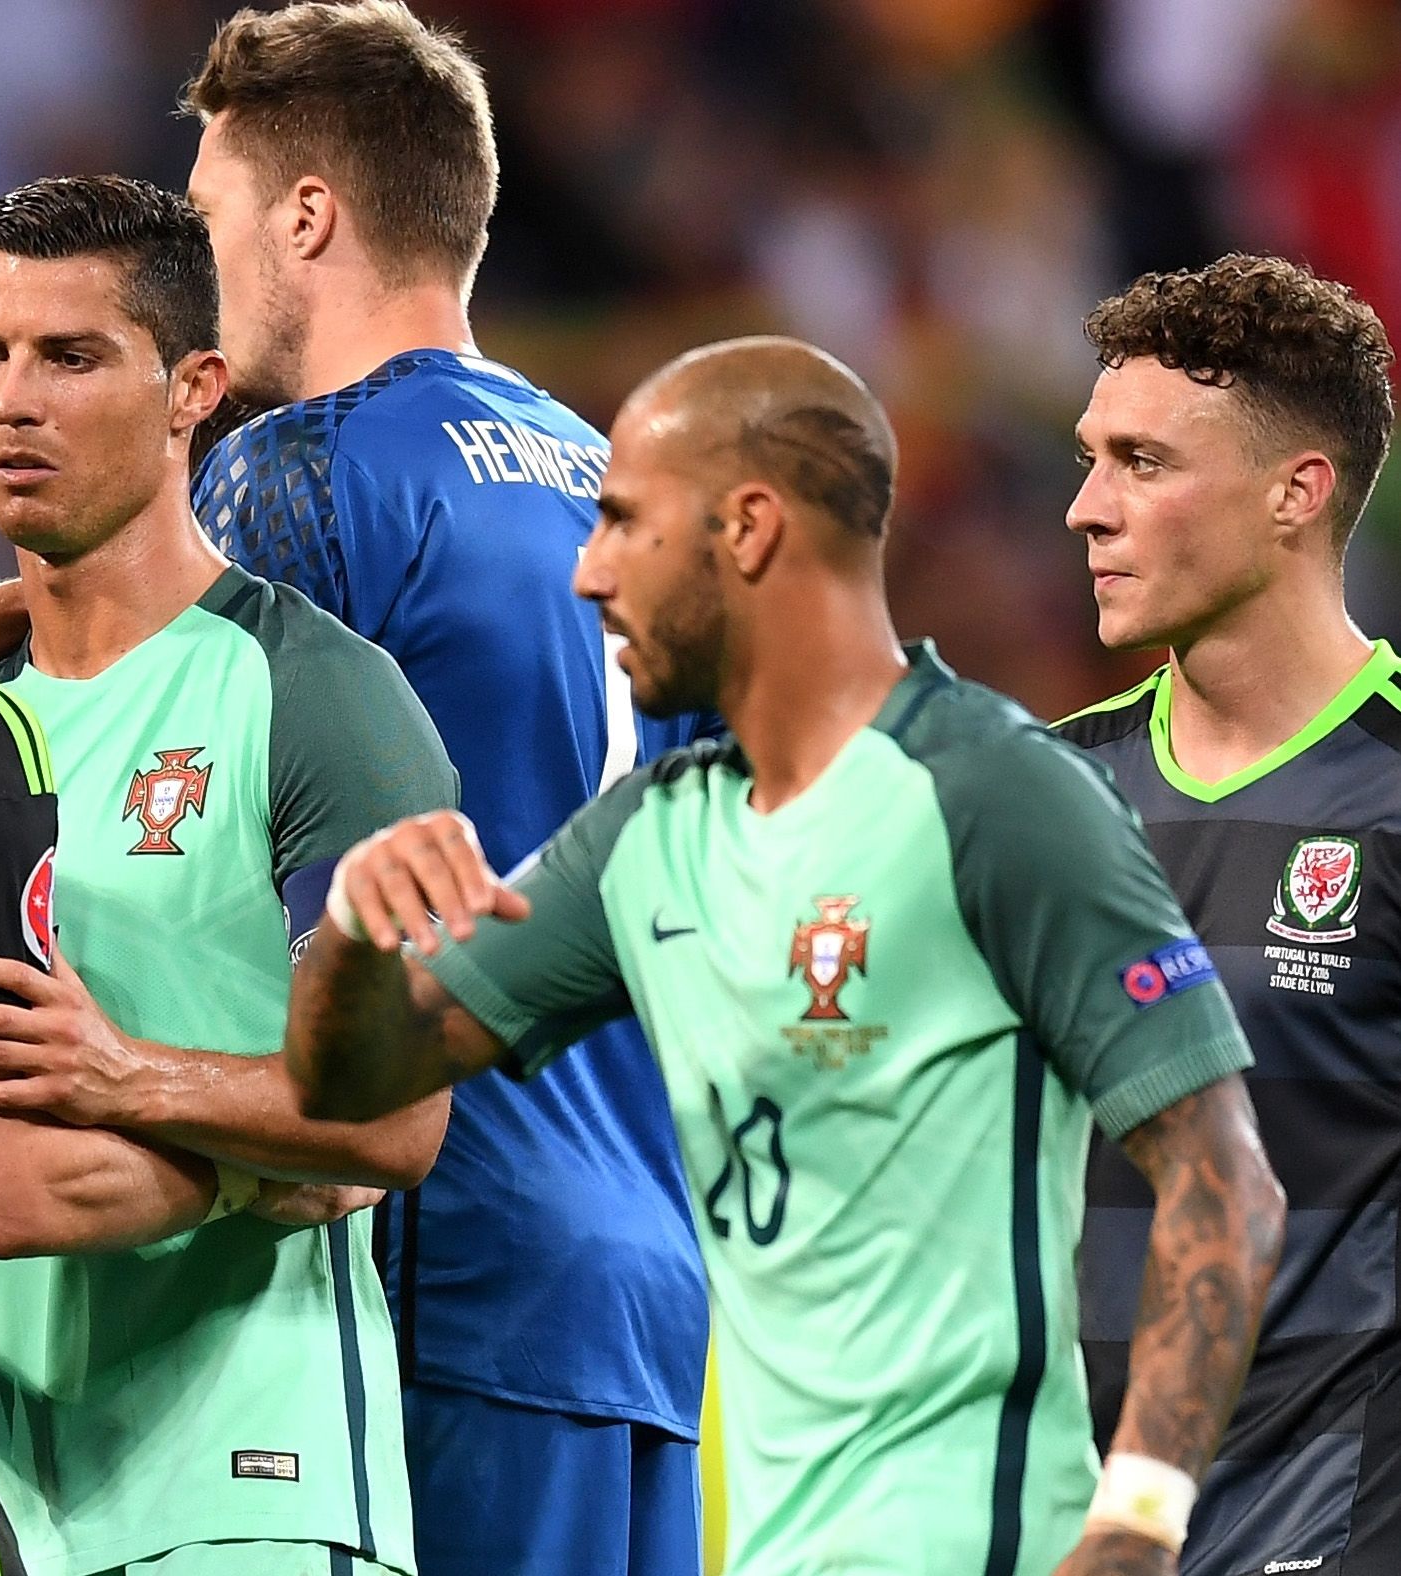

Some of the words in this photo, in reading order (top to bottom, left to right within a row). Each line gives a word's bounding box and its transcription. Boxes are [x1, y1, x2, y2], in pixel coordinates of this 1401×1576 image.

[440, 420, 612, 501] HENNESS
[1264, 945, 1307, 963] PORTUGAL
[1308, 950, 1320, 965] VS
[1321, 953, 1352, 969] WALES
[1277, 961, 1288, 974] 06
[1289, 963, 1311, 978] JULY
[1311, 966, 1330, 981] 2016
[1269, 974, 1297, 990] STADE
[1297, 978, 1310, 992] DE
[1310, 980, 1335, 996] LYON
